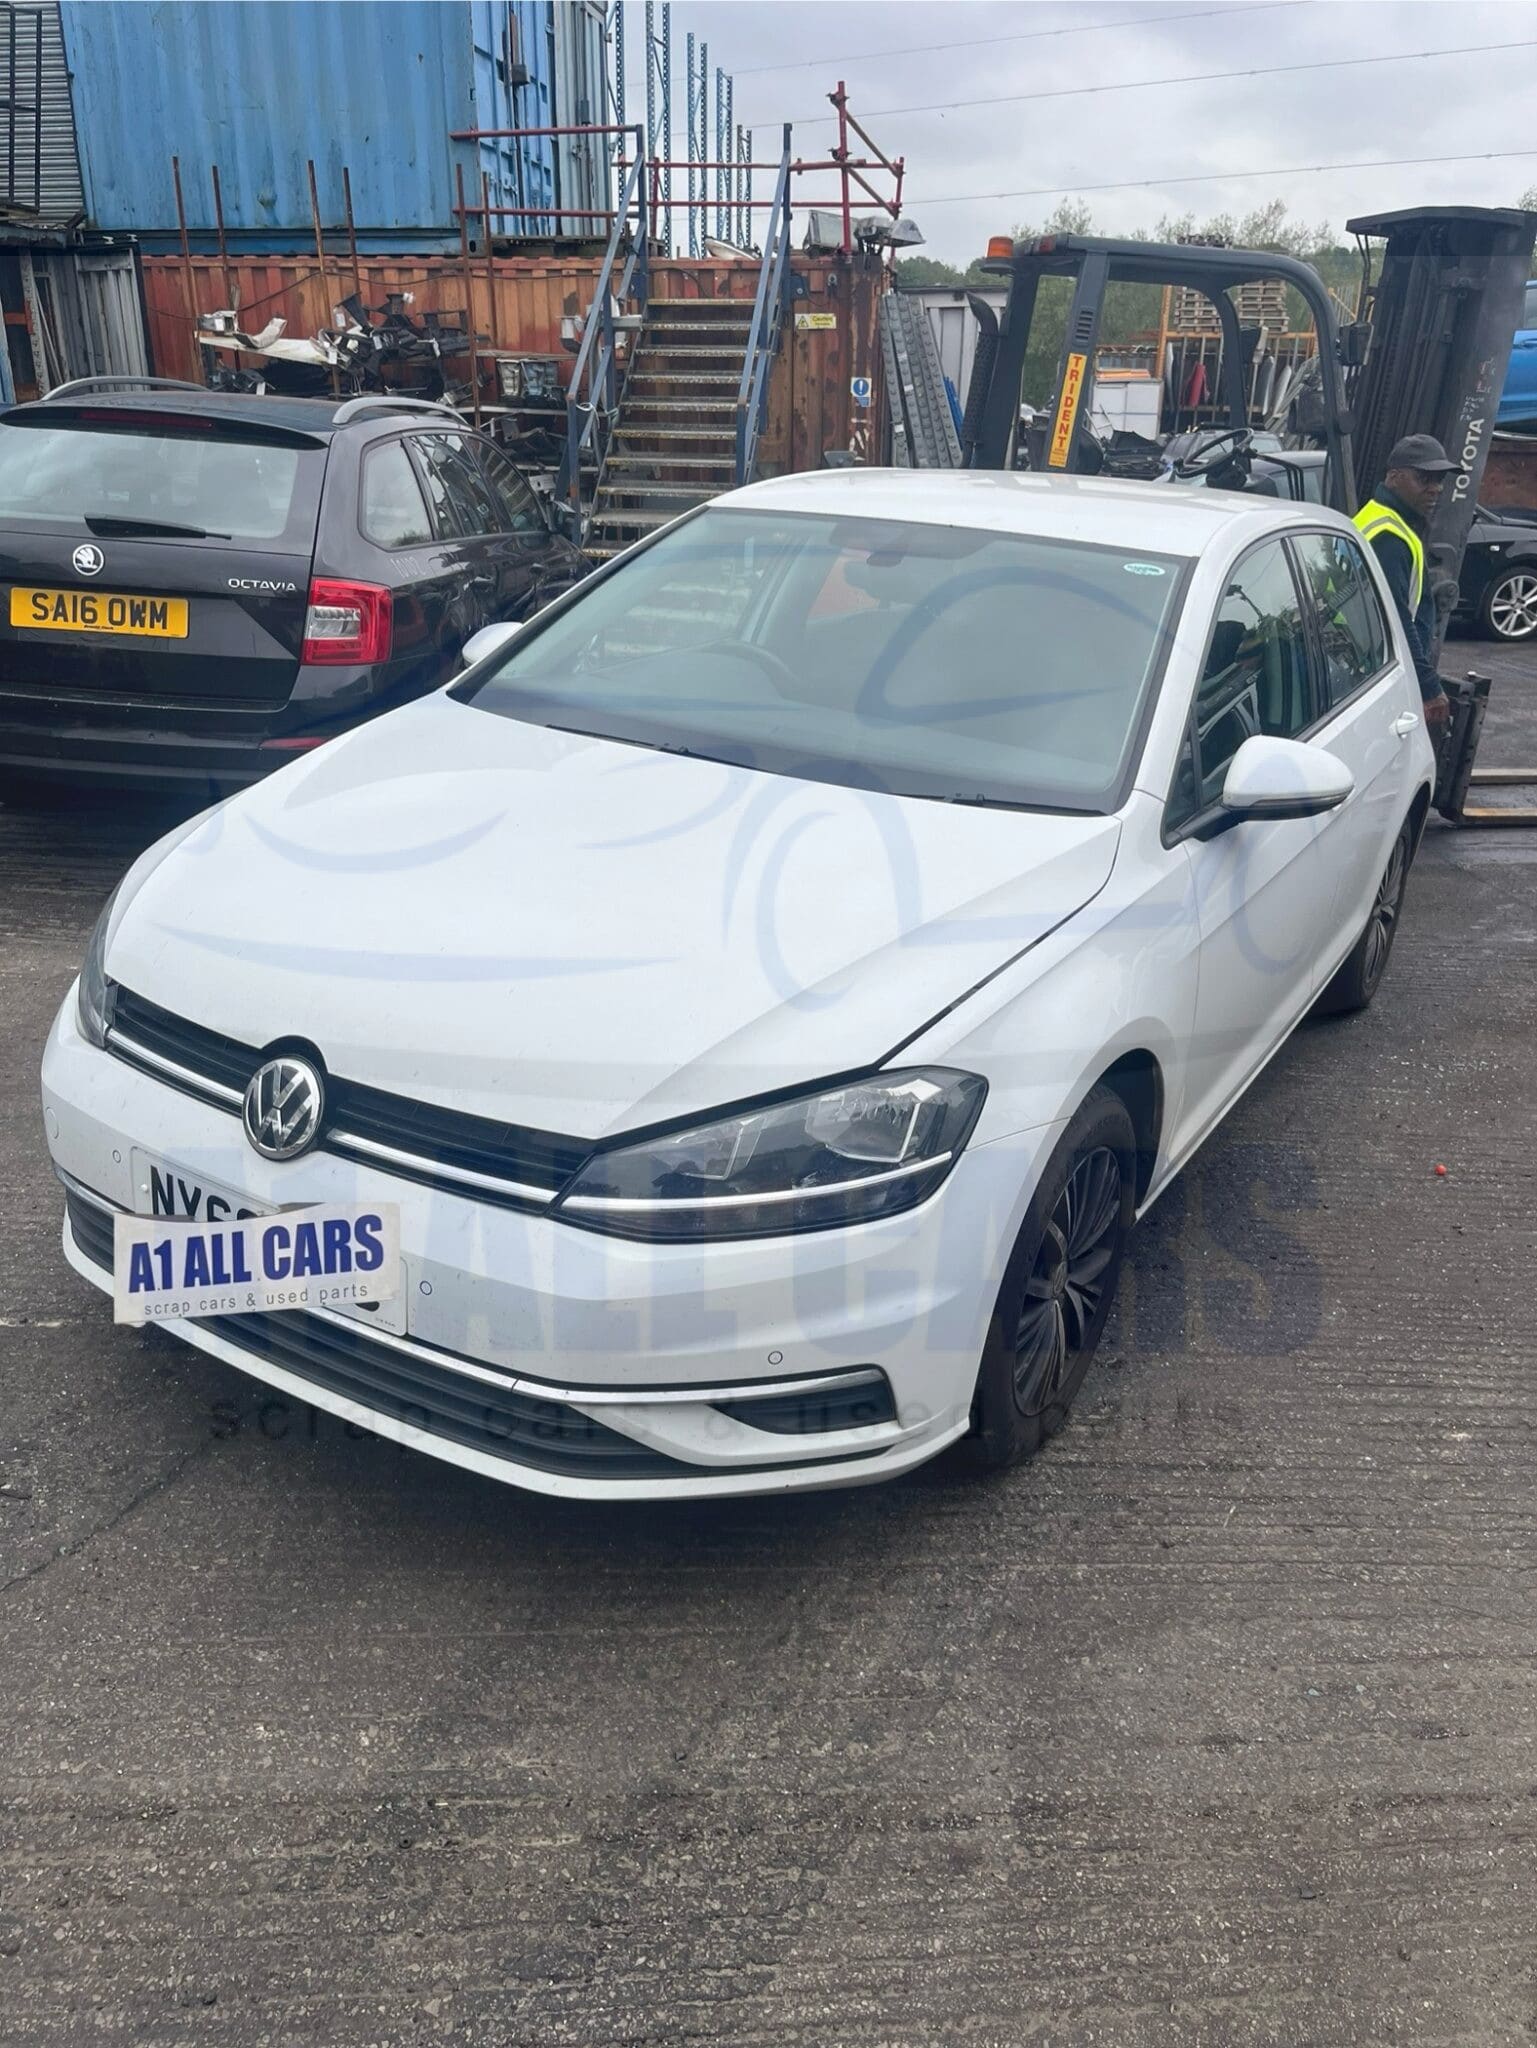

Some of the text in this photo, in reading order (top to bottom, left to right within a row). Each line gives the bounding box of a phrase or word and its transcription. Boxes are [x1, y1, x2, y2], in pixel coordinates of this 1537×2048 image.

[1057, 355, 1083, 448] TRIDENT
[1451, 418, 1485, 503] TOYOTA
[31, 592, 168, 630] SA16 OWM
[228, 578, 297, 592] OCTAVIA
[129, 1214, 385, 1294] A1 ALL CARS
[144, 1283, 368, 1318] scrap cars & used parts
